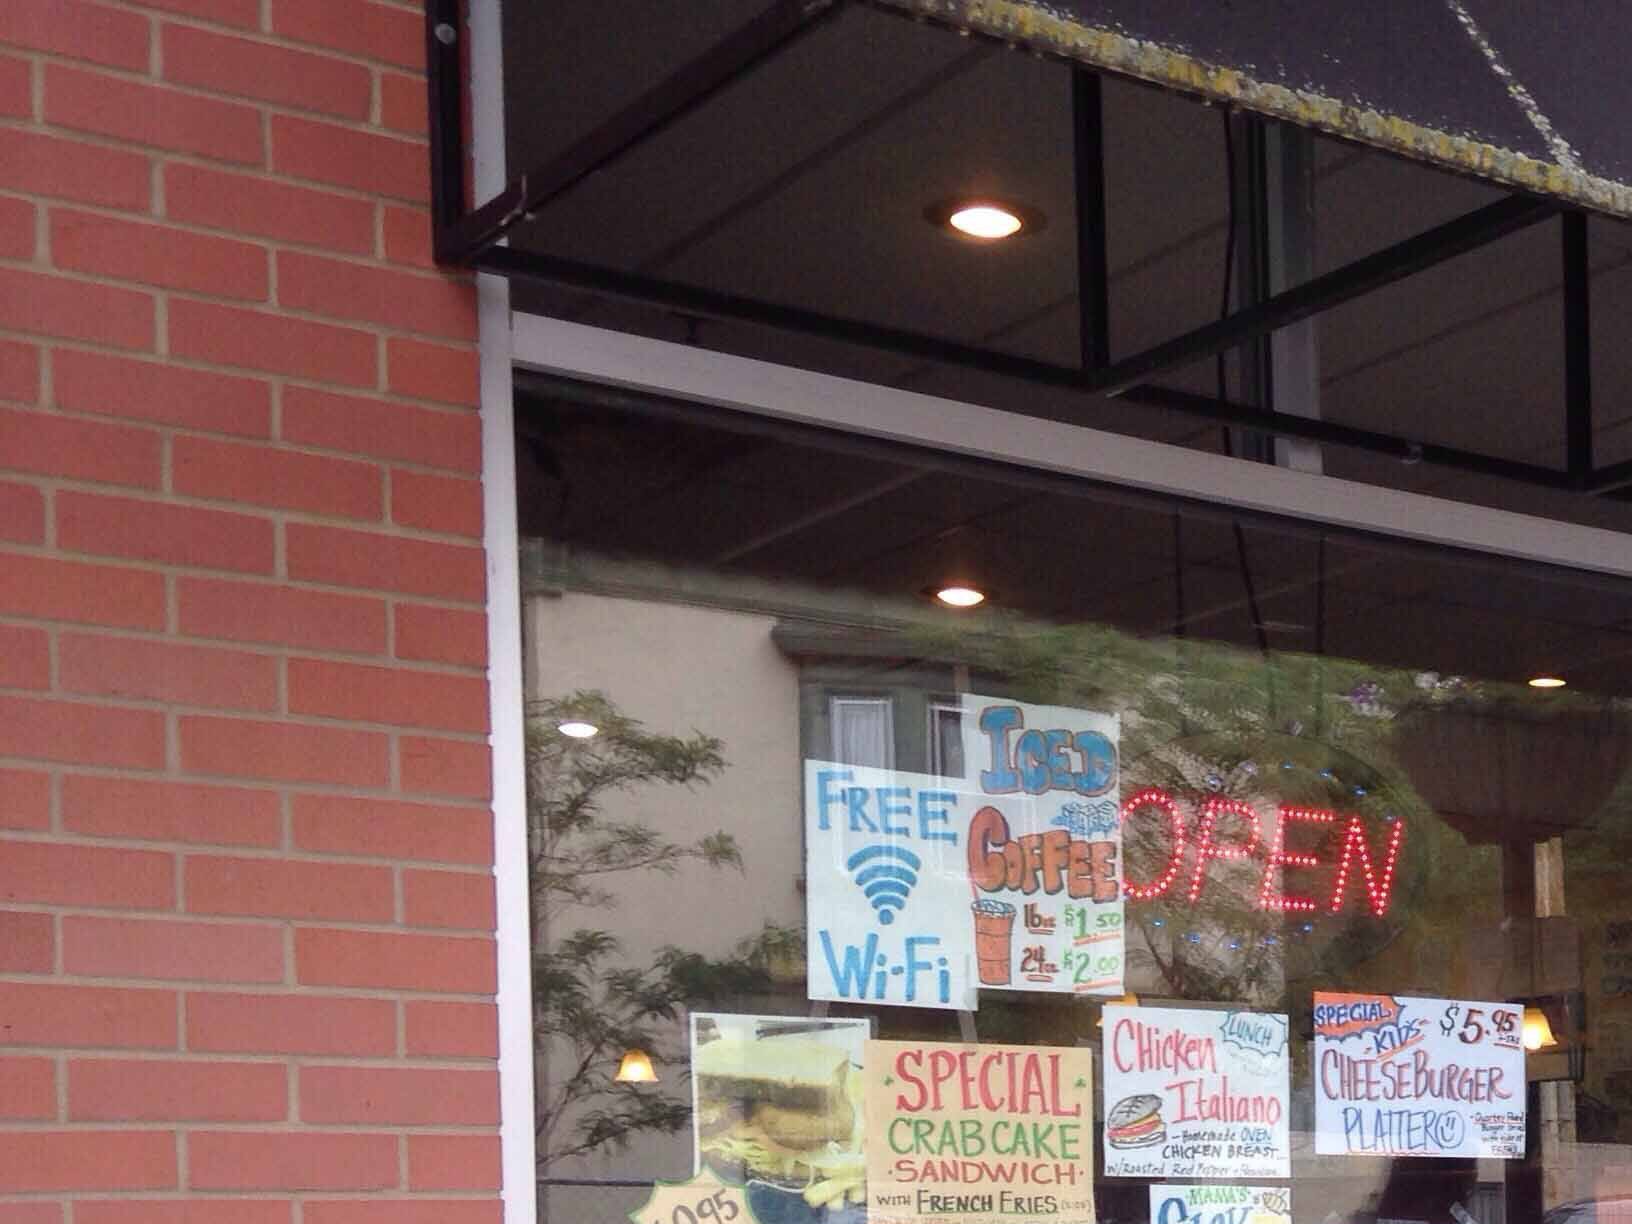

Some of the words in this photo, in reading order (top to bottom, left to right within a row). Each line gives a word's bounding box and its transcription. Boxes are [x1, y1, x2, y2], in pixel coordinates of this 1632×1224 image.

[979, 705, 1118, 797] ICED
[815, 769, 958, 846] FREE
[1119, 786, 1402, 917] OPEN
[818, 929, 951, 1004] Wi-Fi
[1228, 1014, 1273, 1047] LUNCH
[1314, 1002, 1392, 1026] SPECIAL
[895, 1049, 1081, 1117] SPECIAL
[888, 1117, 986, 1157] CRAB
[992, 1120, 1081, 1160] CAKE
[1240, 1127, 1273, 1143] OVEN
[1342, 1107, 1438, 1152] PLATTER
[895, 1160, 1076, 1185] SANDWICH
[1162, 1145, 1223, 1160] CHICKEN
[916, 1190, 993, 1215] FRENCH
[1000, 1190, 1058, 1215] FRIES
